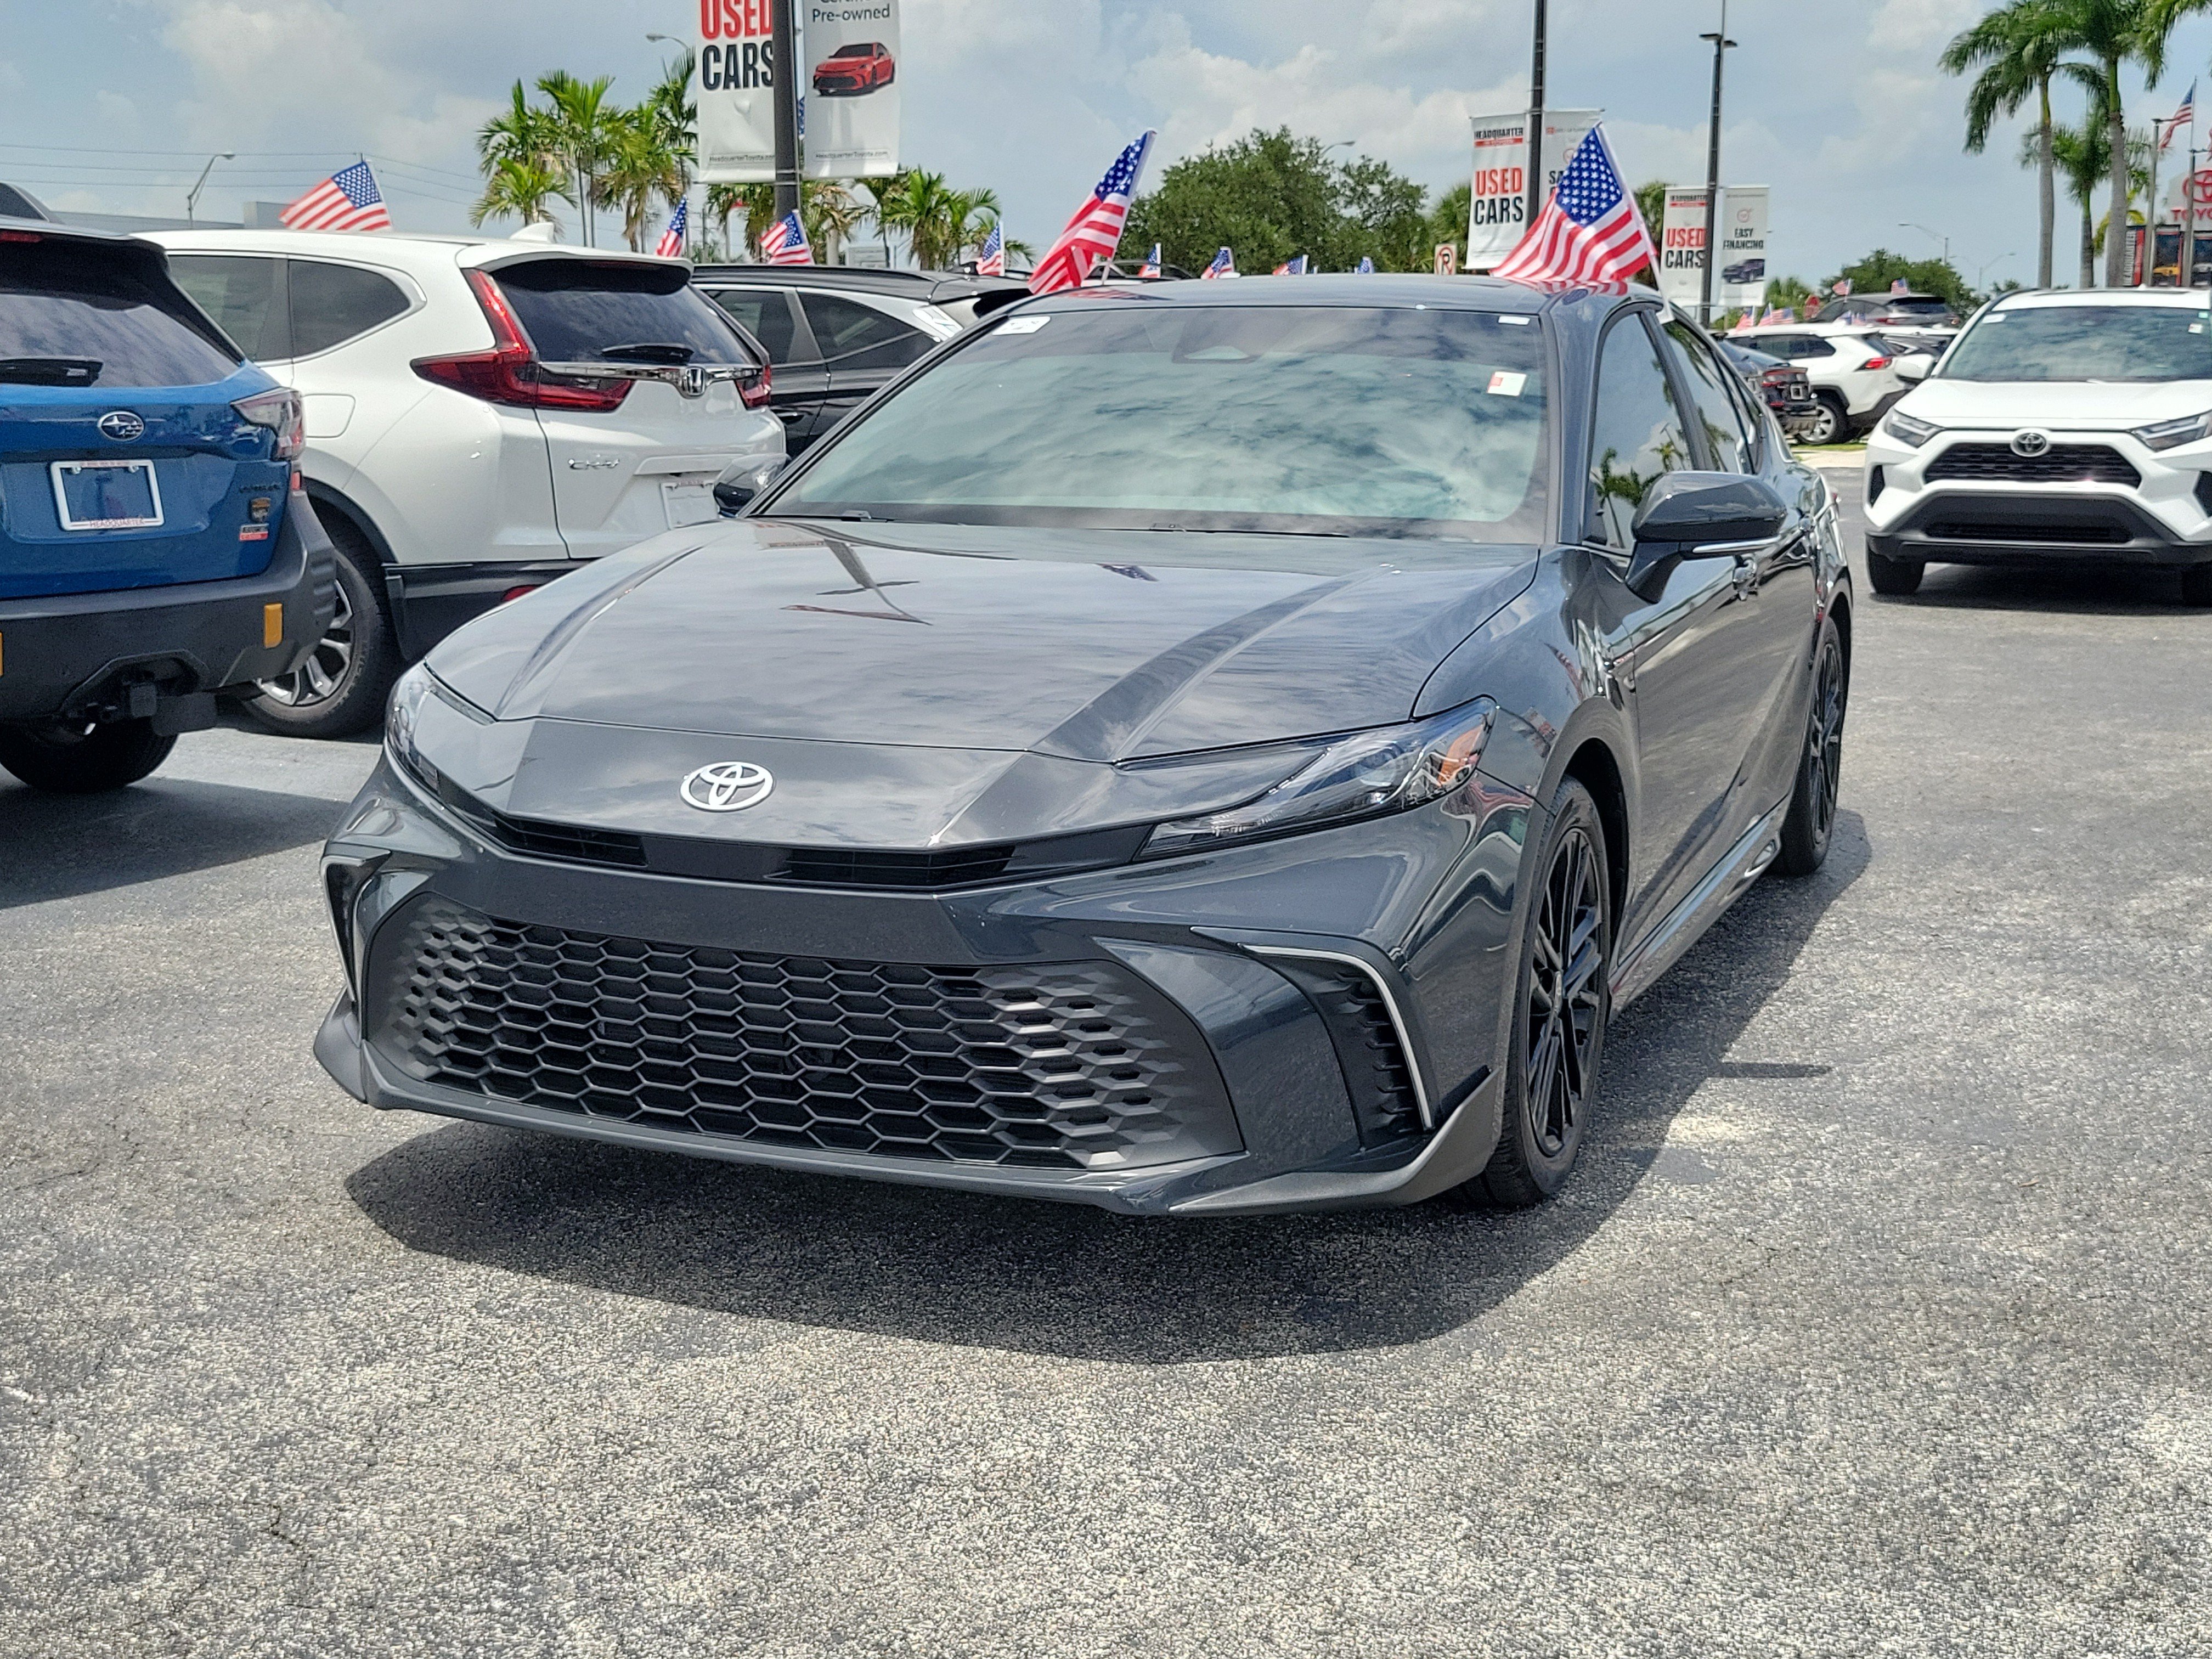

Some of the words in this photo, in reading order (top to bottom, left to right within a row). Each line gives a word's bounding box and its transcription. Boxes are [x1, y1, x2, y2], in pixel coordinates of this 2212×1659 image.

[701, 0, 773, 40] USED
[812, 3, 890, 23] Pre-owned
[702, 40, 774, 91] CARS
[1476, 167, 1522, 196] USED
[1475, 196, 1523, 225] CARS
[1667, 228, 1706, 247] USED
[1666, 250, 1705, 269] CARS
